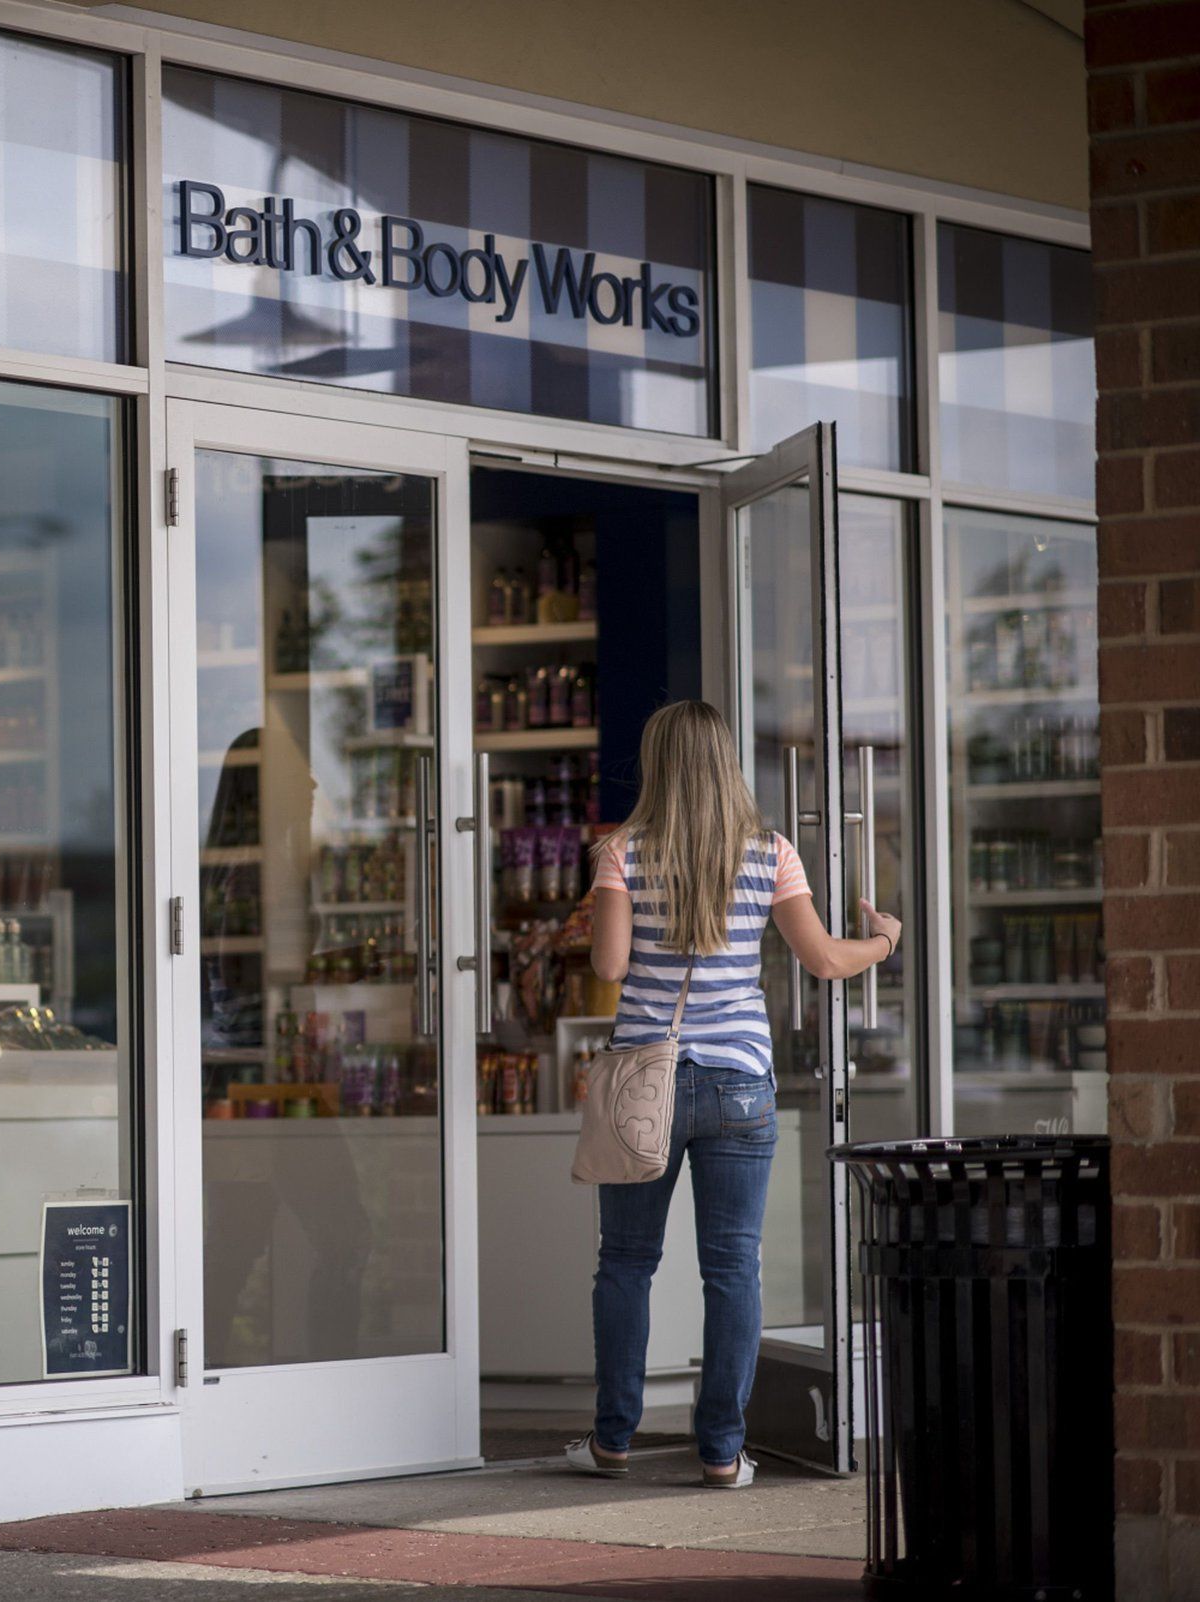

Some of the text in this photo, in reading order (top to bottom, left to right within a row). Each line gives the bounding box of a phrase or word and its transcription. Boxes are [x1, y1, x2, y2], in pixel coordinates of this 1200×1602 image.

[178, 179, 700, 338] Bath & Body Works
[67, 1224, 105, 1236] welcome
